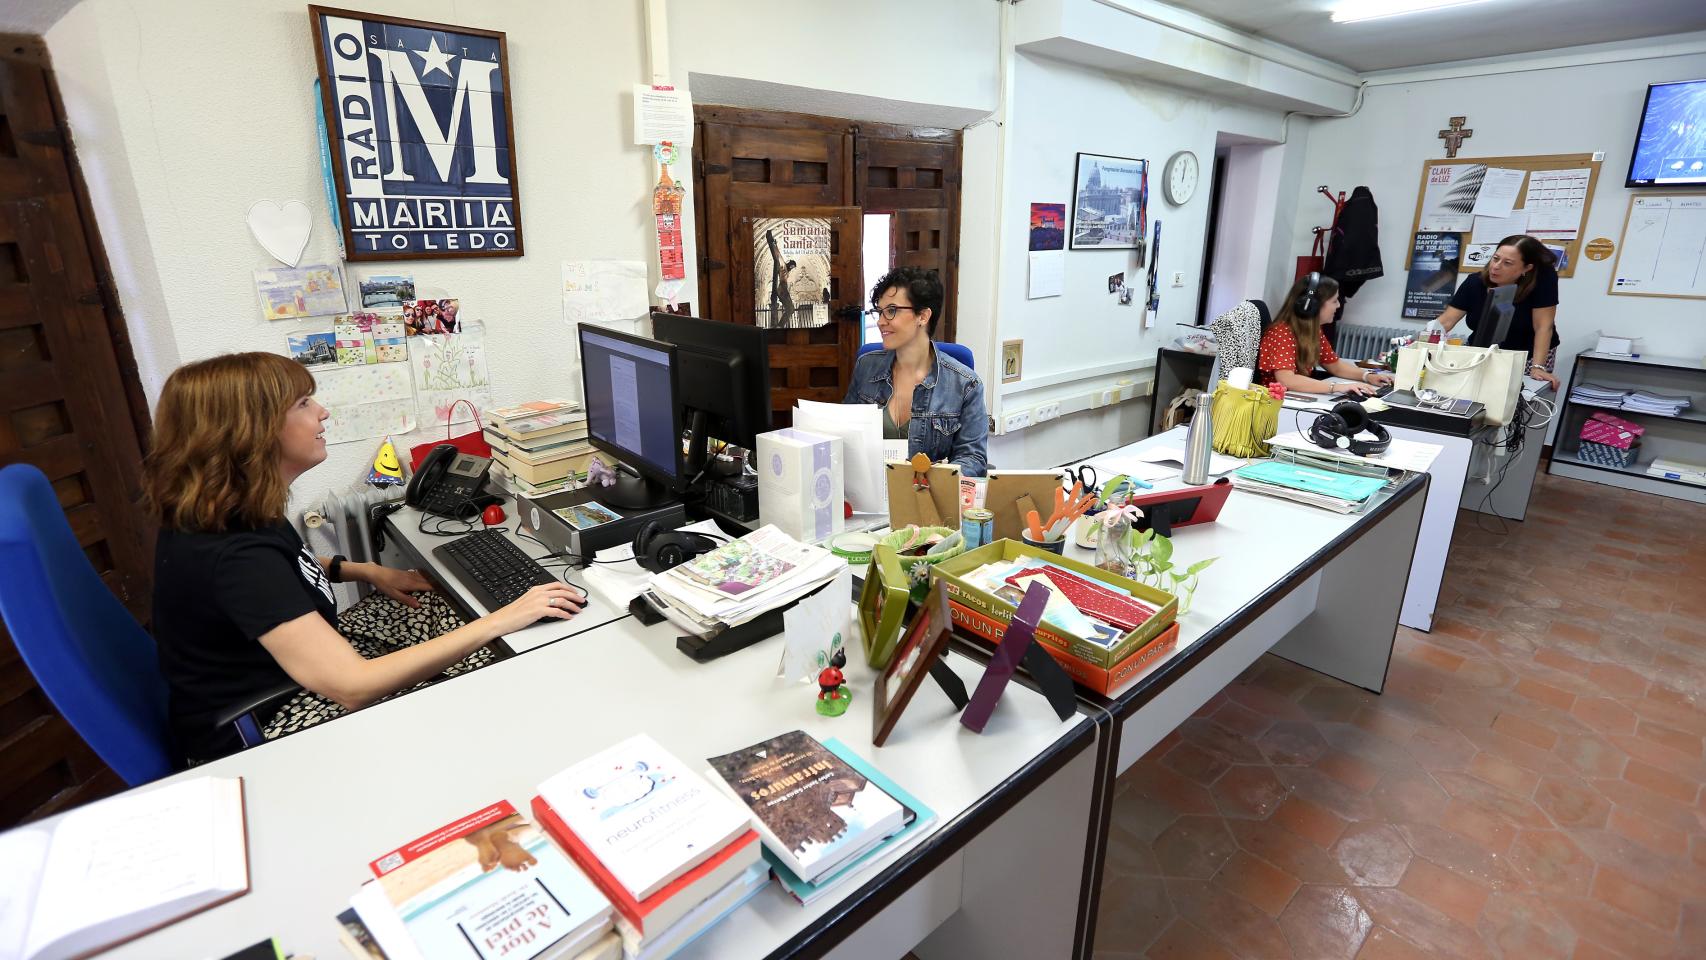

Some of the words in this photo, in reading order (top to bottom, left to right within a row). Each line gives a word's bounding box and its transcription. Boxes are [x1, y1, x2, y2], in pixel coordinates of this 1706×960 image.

[334, 32, 379, 181] RADIO
[1432, 167, 1452, 176] CLAVE
[1438, 175, 1450, 183] LUZ
[352, 201, 513, 227] MARIA
[783, 223, 828, 236] Semana
[365, 232, 510, 251] TOLEDO
[783, 236, 813, 249] Santa
[950, 607, 970, 625] ON
[972, 617, 992, 636] UN
[750, 759, 833, 800] Intramuros
[605, 787, 702, 846] neurofitness
[526, 903, 550, 921] de
[537, 916, 552, 930] A
[484, 917, 523, 950] piel
[500, 928, 537, 957] flor
